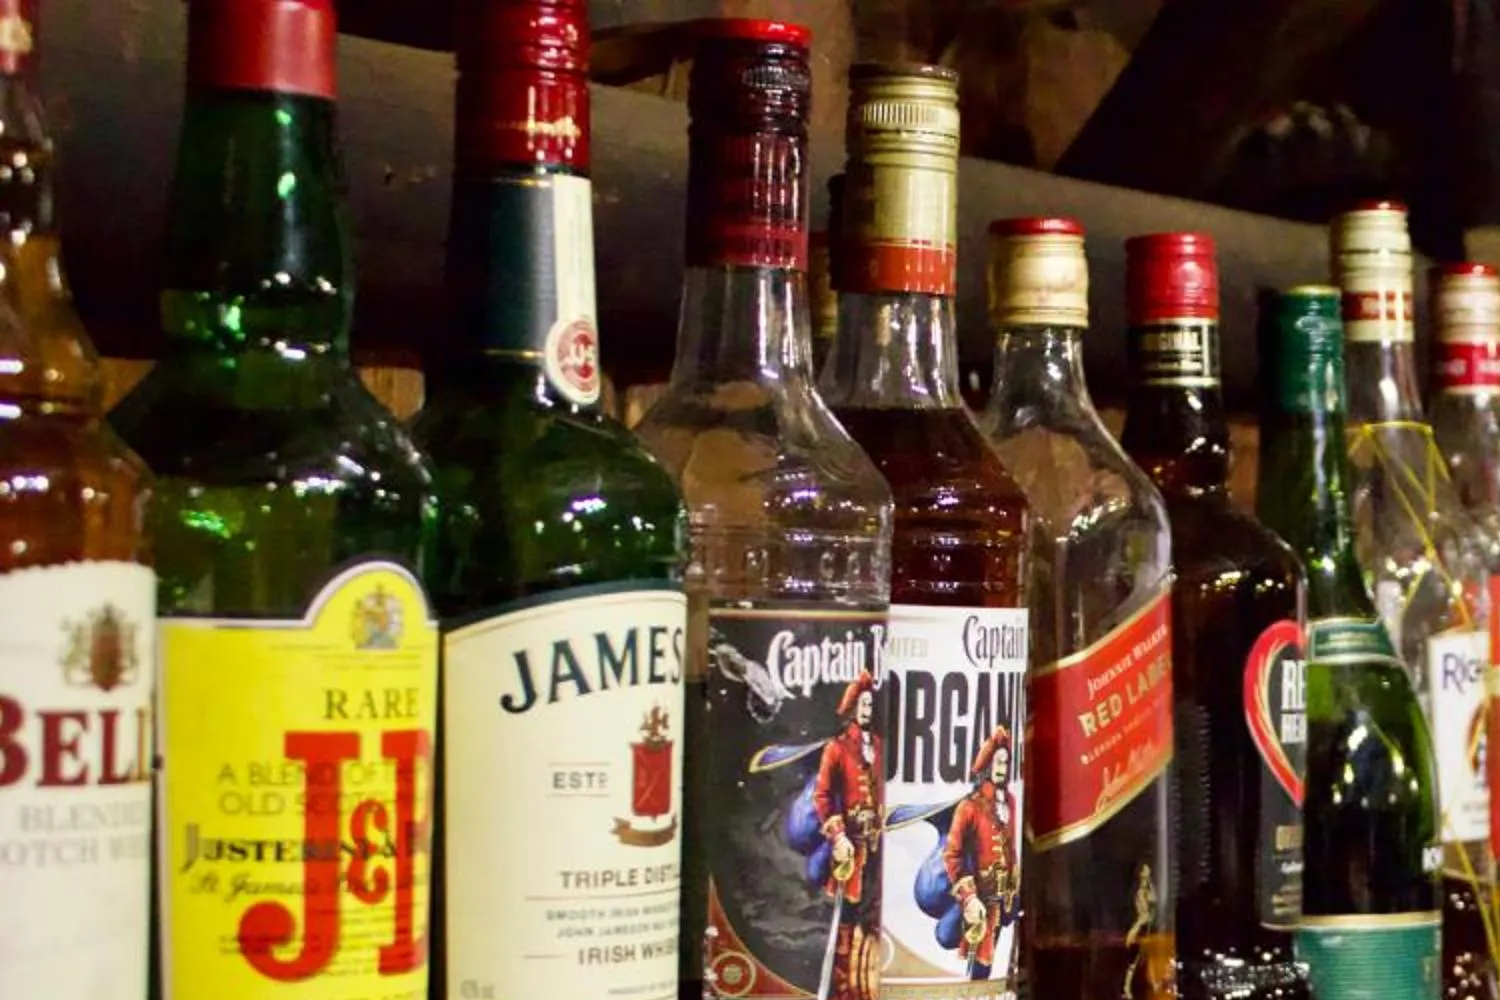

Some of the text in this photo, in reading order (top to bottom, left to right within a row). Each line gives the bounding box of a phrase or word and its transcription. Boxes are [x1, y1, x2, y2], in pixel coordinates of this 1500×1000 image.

[766, 630, 866, 698] Captain
[323, 687, 419, 720] RARE
[1078, 693, 1123, 738] RED
[219, 791, 286, 816] OLD
[560, 866, 639, 890] TRIPLE
[578, 945, 637, 966] IRISH
